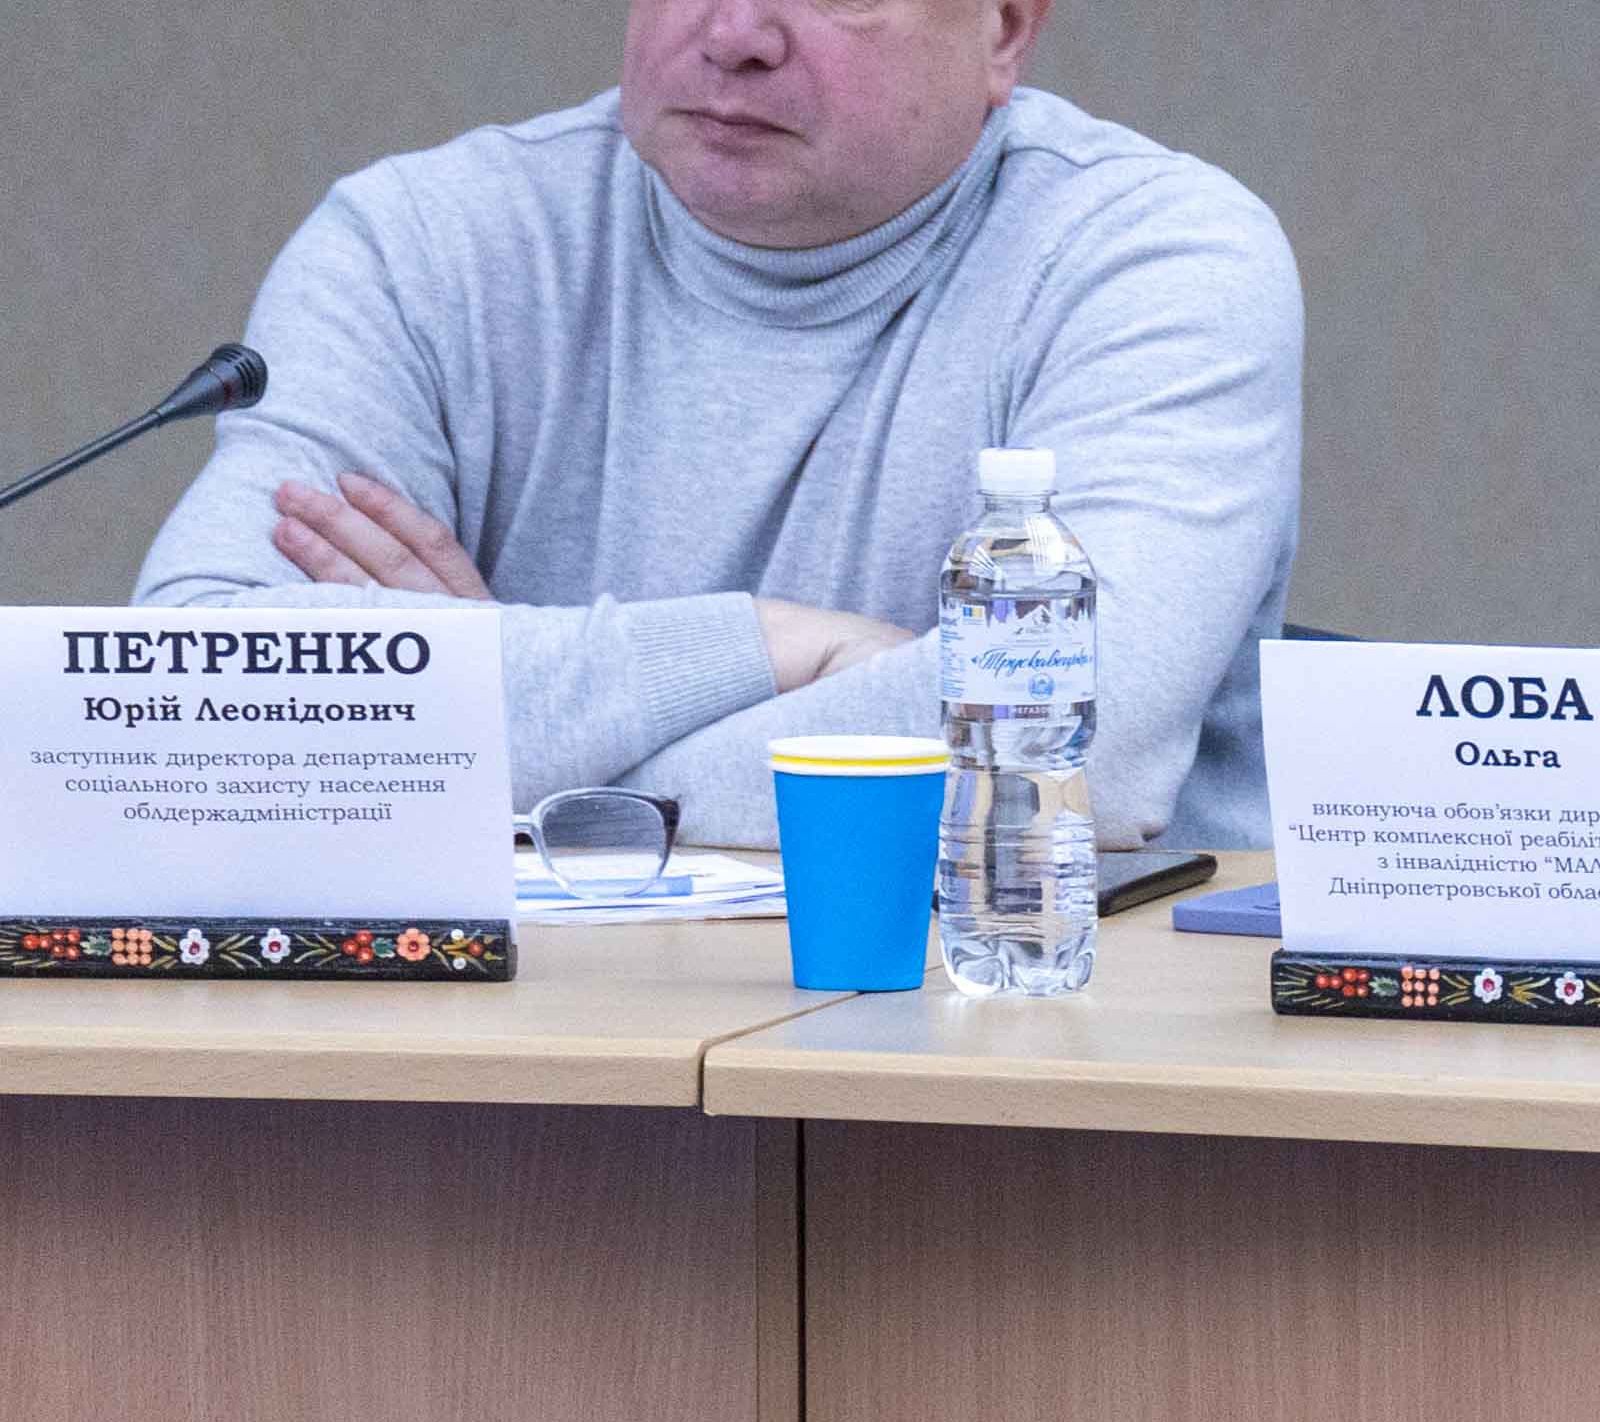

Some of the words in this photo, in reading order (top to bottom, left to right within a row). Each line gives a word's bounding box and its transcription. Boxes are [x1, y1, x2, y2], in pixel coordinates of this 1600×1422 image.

[64, 631, 431, 674] ПЕТРЕНКО
[1416, 675, 1594, 721] ЛОБА
[84, 696, 182, 728] Юрій
[195, 698, 416, 727] Леонідович
[30, 749, 157, 768] заступник
[165, 750, 295, 769] директора
[303, 750, 477, 769] департаменту
[1455, 741, 1561, 769] Ольга
[65, 776, 208, 795] соціального
[216, 778, 310, 797] захисту
[319, 777, 446, 793] населення
[123, 802, 392, 825] облдержадміністрації
[1312, 802, 1437, 823] виконуюча
[1374, 828, 1513, 847] комплексної
[1377, 857, 1389, 870] з
[1396, 852, 1538, 874] інвалідністю
[1329, 877, 1541, 901] Дніпропетровської
